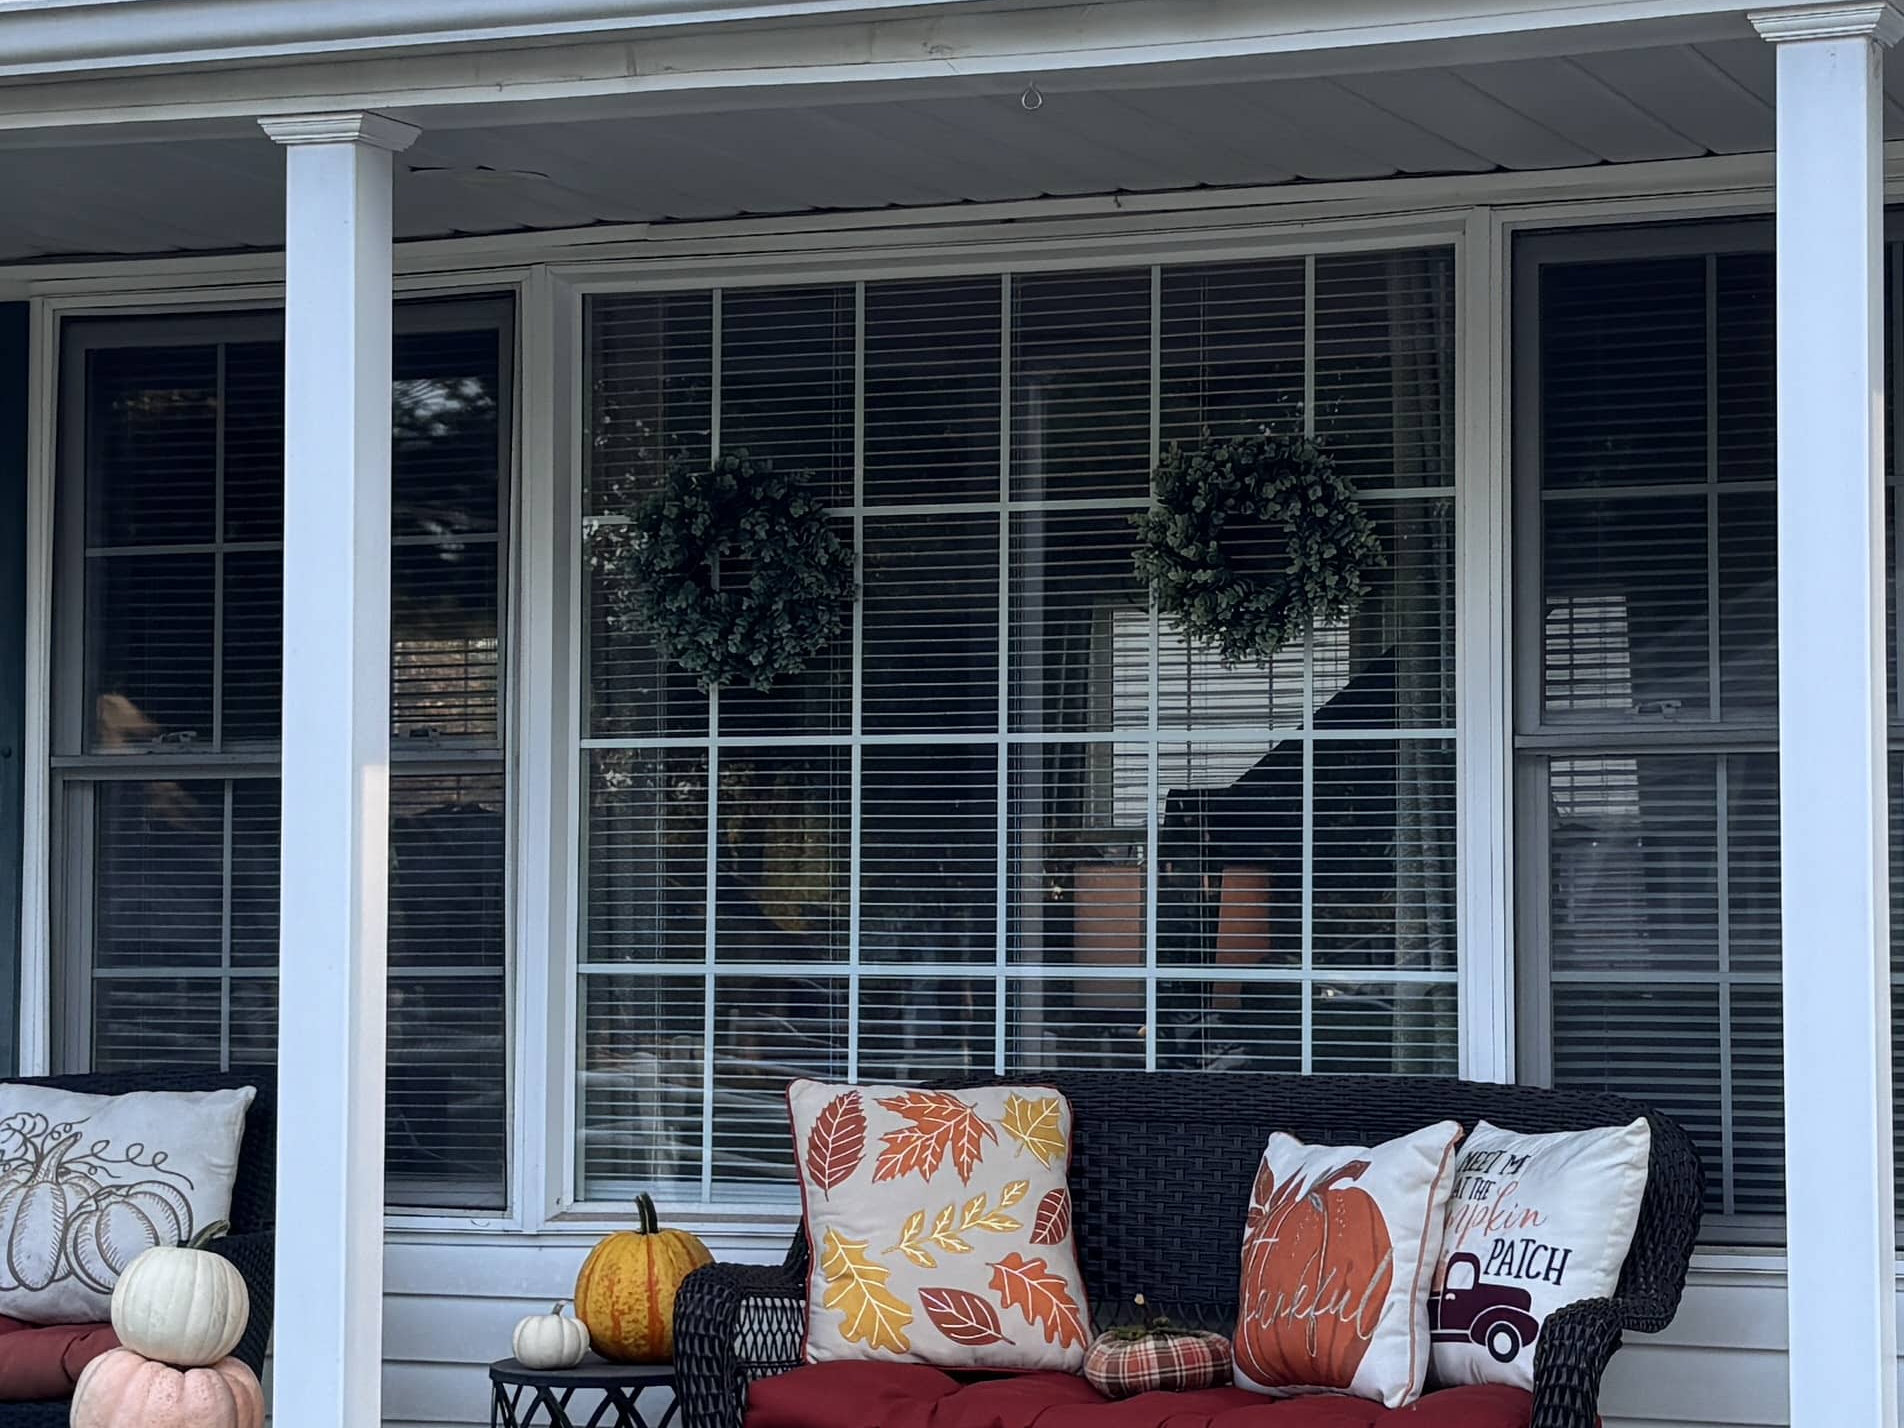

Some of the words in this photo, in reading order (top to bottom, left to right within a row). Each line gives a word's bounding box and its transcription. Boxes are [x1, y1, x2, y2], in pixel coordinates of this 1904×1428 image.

[1457, 1149, 1508, 1174] MEET
[1468, 1176, 1496, 1201] THE
[1483, 1237, 1573, 1286] PATCH
